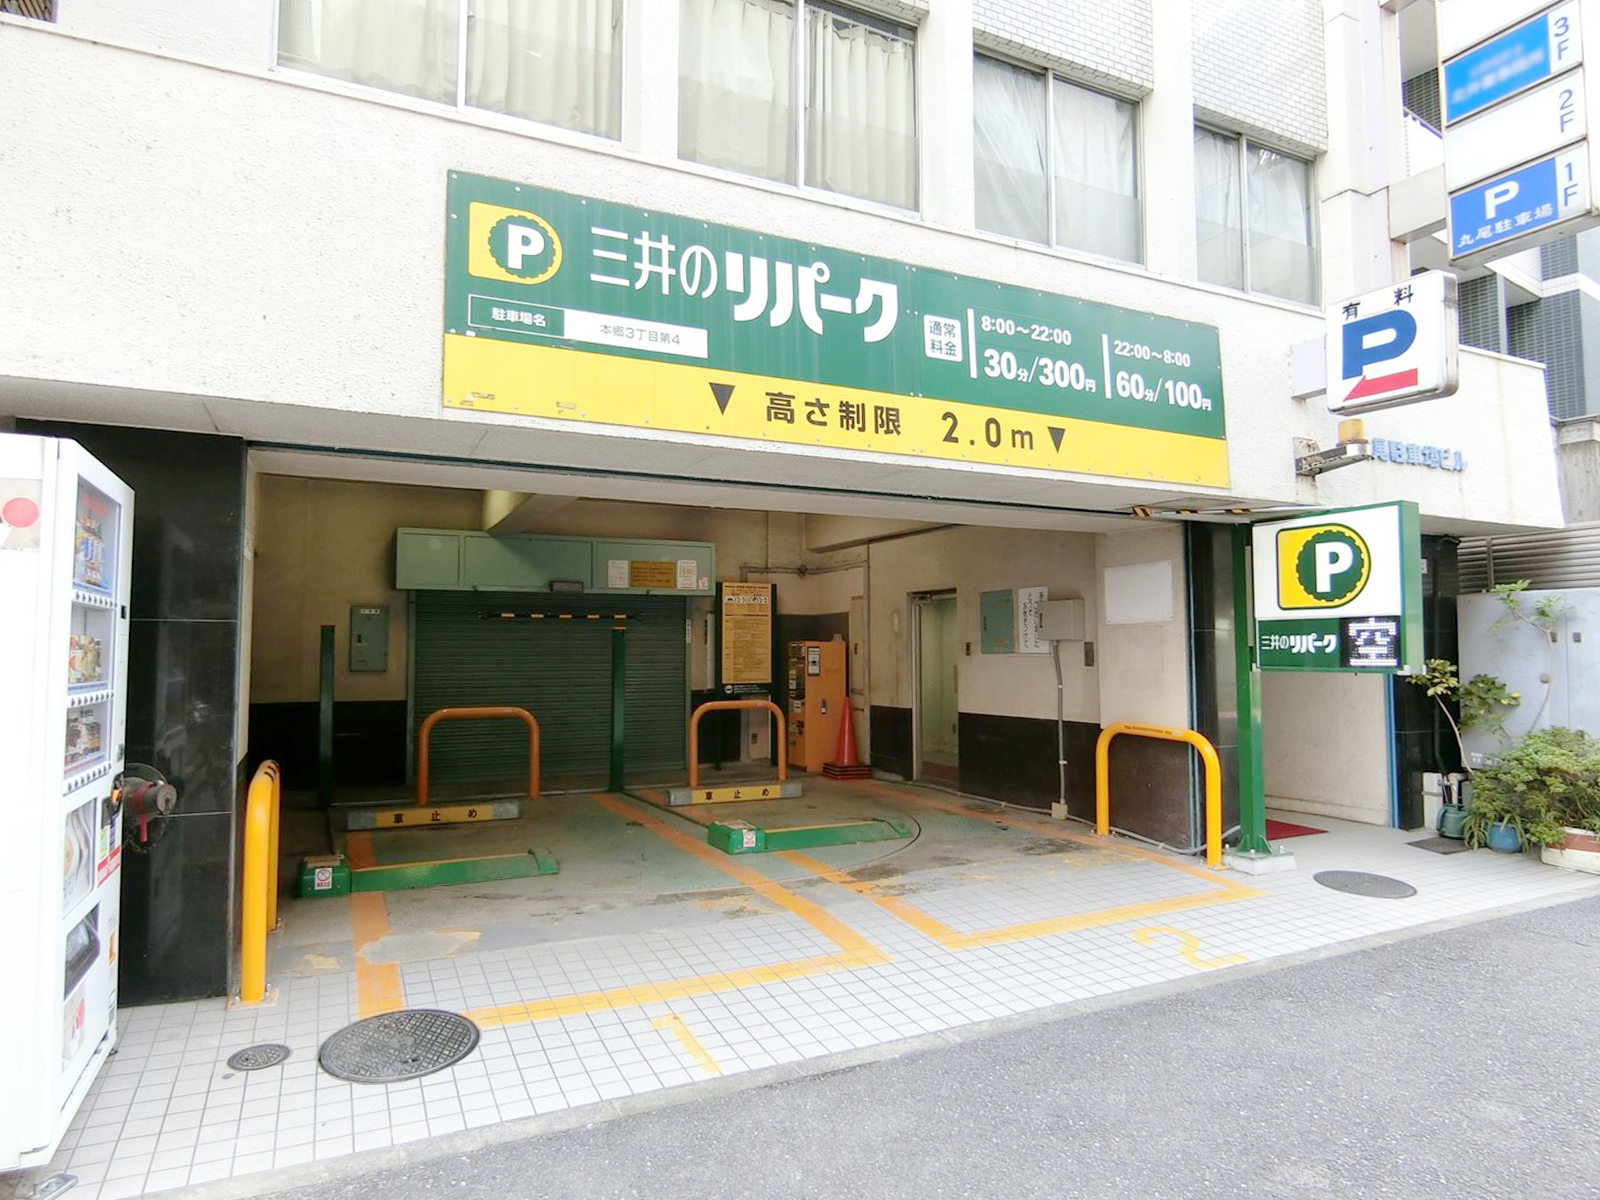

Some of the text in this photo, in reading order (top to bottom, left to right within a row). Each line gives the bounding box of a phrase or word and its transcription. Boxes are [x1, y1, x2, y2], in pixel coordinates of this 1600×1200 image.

[1485, 180, 1520, 220] P
[507, 224, 545, 269] P
[1457, 203, 1555, 248] 丸尾駐車場
[590, 226, 898, 342] 三井のリパーク
[491, 306, 547, 328] 駐車場名
[600, 324, 681, 346] 本郷3丁目第4
[928, 319, 956, 339] 通常
[929, 338, 958, 358] 料金
[1342, 309, 1417, 380] P
[765, 391, 1034, 450] 高さ制限 2.0m
[1315, 541, 1353, 593] P
[1261, 633, 1337, 654] 三井のリパーク
[1348, 617, 1397, 667] 空
[393, 807, 478, 825] 車止め
[1131, 926, 1250, 971] 2
